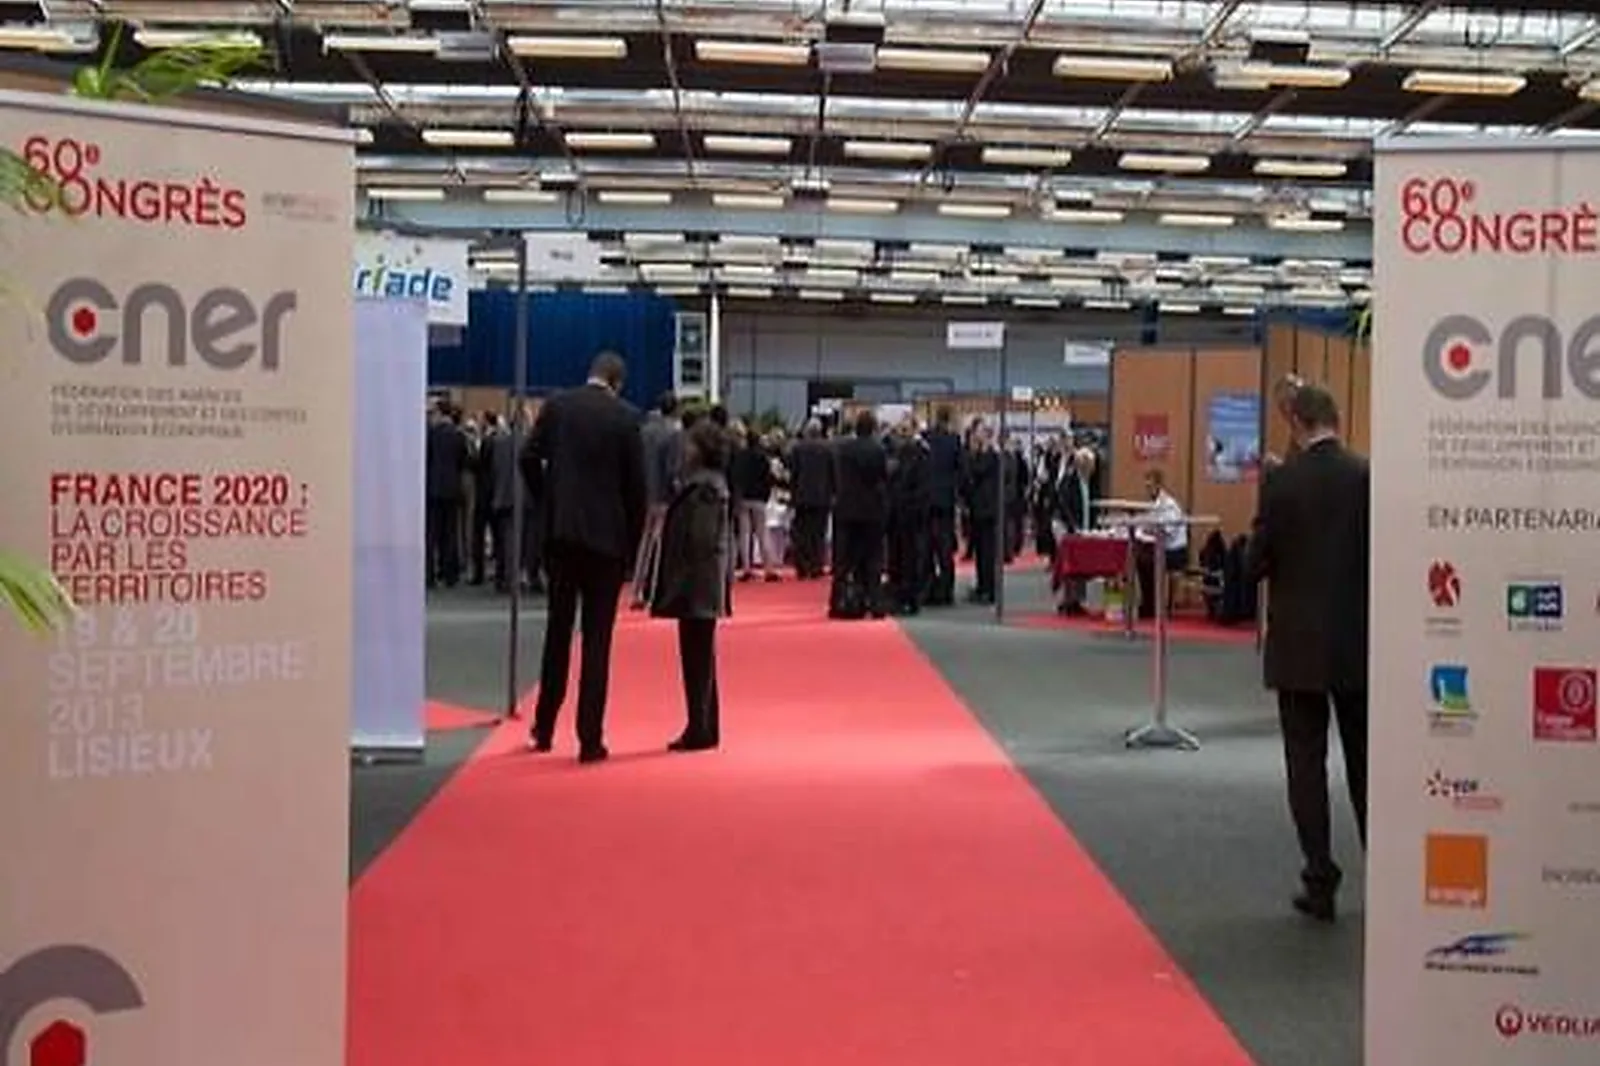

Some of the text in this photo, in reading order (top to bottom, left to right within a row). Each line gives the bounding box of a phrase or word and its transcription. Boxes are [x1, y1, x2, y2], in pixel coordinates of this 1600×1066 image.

[46, 277, 298, 371] cner
[50, 473, 203, 505] FRANCE
[213, 474, 290, 506] 2020
[51, 506, 308, 539] LA CROISSANCE
[1428, 507, 1600, 531] EN PARTENARI
[51, 541, 188, 573] PAR LES
[153, 604, 203, 645] 20
[48, 641, 305, 693] SEPTEMBRE
[48, 692, 144, 736] 2013
[47, 727, 214, 780] LISIEUX
